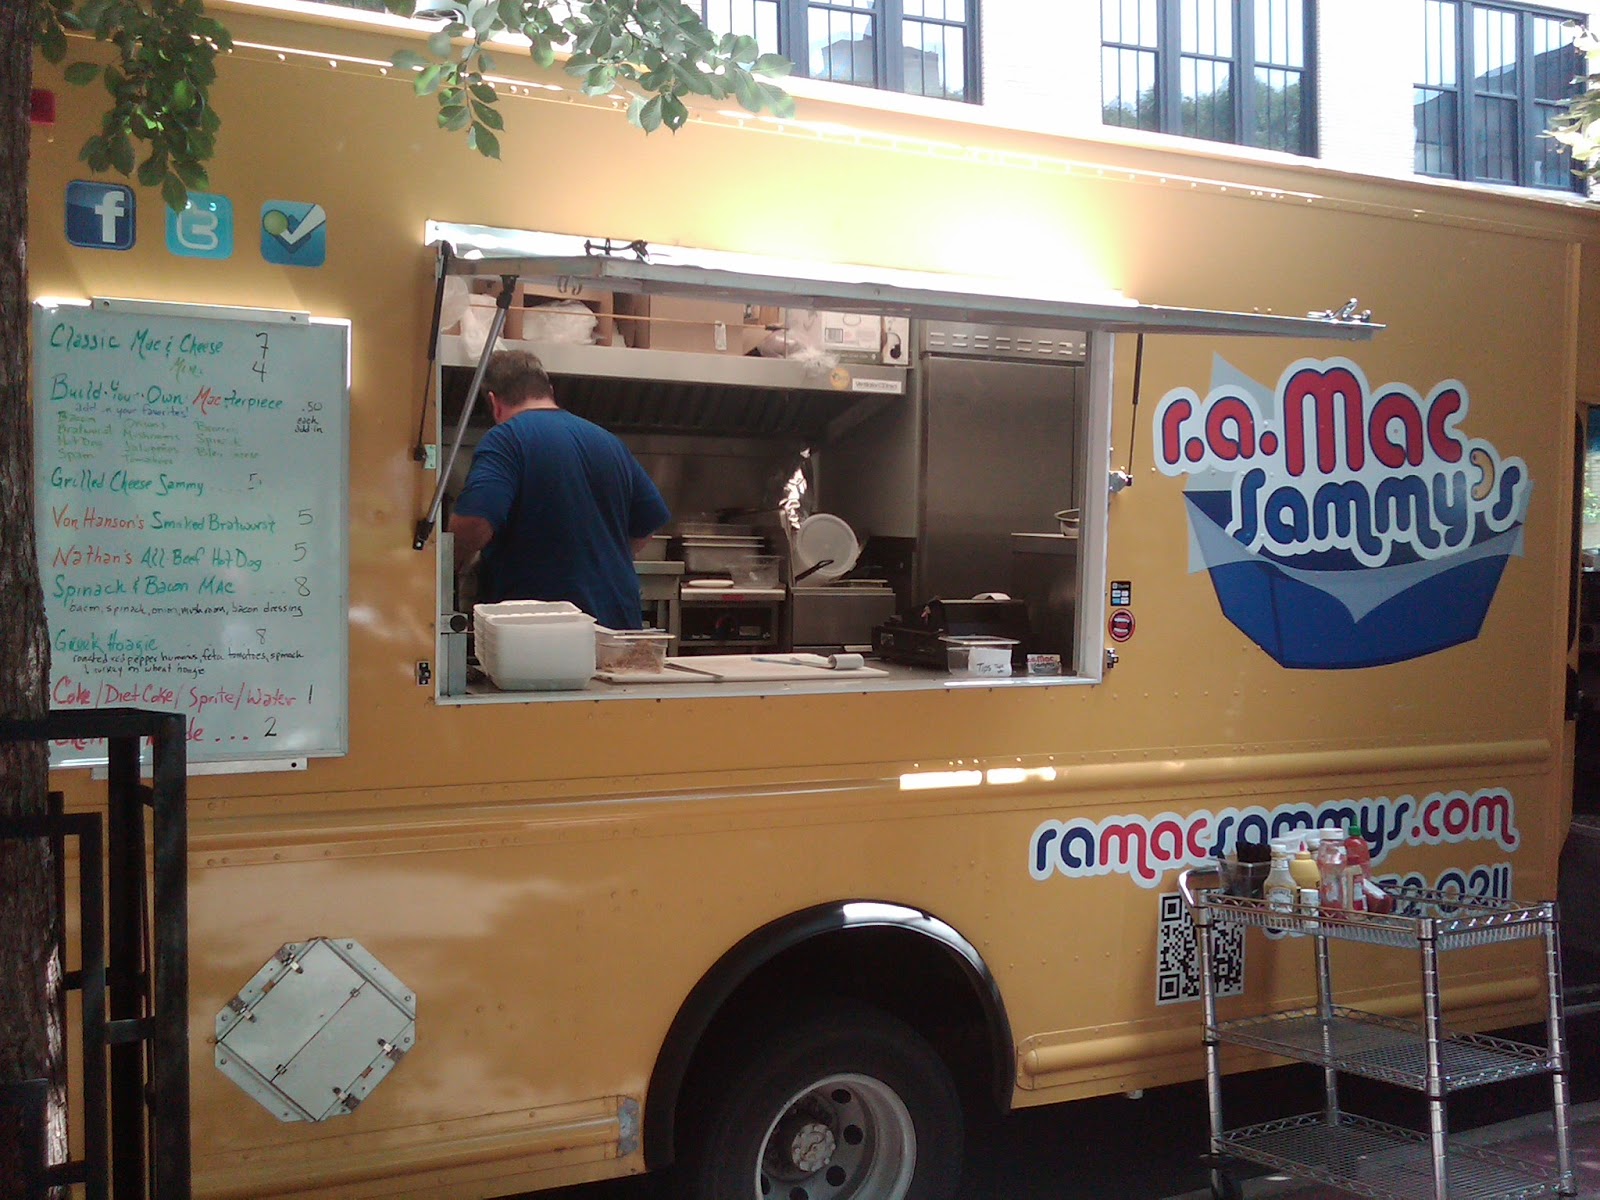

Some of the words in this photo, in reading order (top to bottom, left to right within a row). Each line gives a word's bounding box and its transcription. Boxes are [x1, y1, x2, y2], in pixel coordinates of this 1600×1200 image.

[50, 323, 120, 352] Classic
[130, 328, 161, 360] Mac
[180, 333, 223, 356] Cheese
[255, 332, 269, 359] 7
[251, 361, 267, 383] 4
[50, 372, 102, 401] Build
[146, 385, 184, 404] Own
[51, 467, 106, 492] Grilled
[109, 470, 153, 496] Cheese
[156, 473, 204, 497] Sammy
[52, 503, 79, 530] Von
[83, 506, 145, 531] Hanson's
[151, 511, 206, 531] Smoked
[208, 512, 277, 533] Bratwurst
[298, 508, 314, 526] 5
[1231, 448, 1521, 558] Sammy's
[52, 545, 134, 569] Nathan's
[141, 546, 165, 569] All
[173, 546, 206, 566] Beef
[235, 548, 262, 573] Dog
[292, 541, 307, 563] 5
[144, 575, 190, 596] Bacon
[294, 576, 311, 597] 8
[262, 601, 304, 618] dressing
[106, 629, 159, 656] Hoagie
[255, 628, 267, 645] 8
[264, 717, 277, 738] 2
